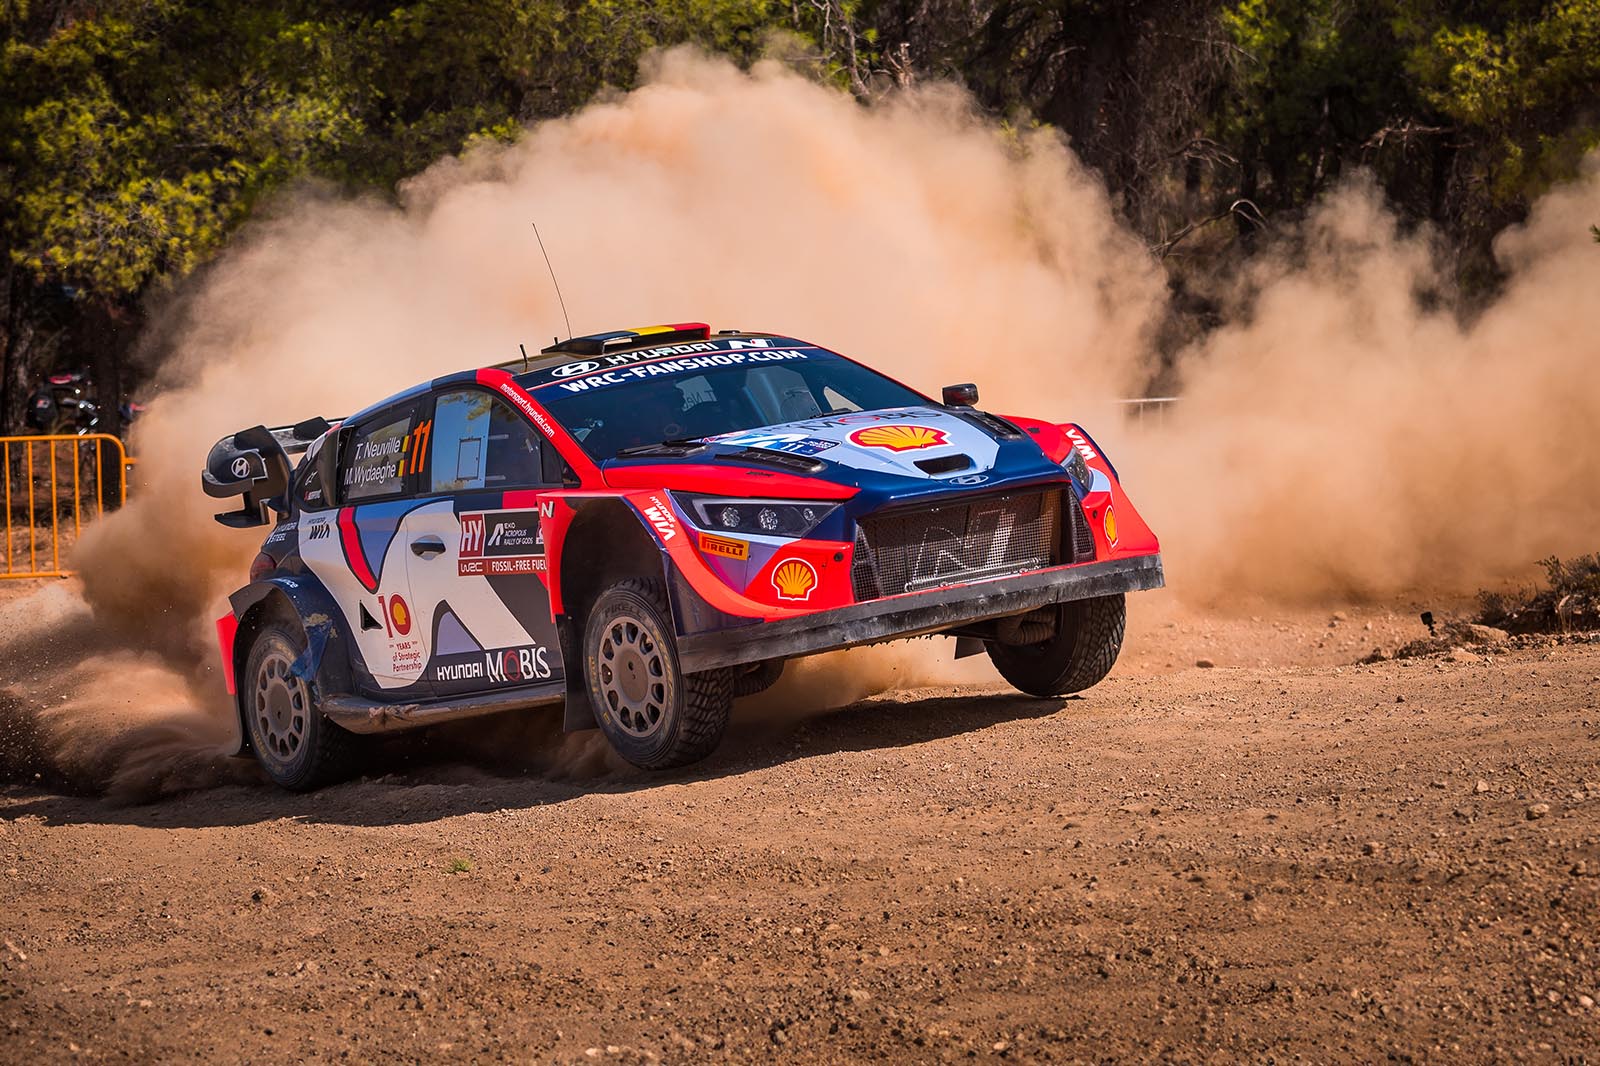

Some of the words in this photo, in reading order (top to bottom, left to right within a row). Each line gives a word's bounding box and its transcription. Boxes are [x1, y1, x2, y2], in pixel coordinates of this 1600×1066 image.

[604, 342, 719, 366] HYUNDAI
[559, 350, 808, 393] WRC-FANSHOP.COM
[500, 383, 556, 438] motorsport.hyundai.com
[355, 443, 364, 460] T.
[363, 437, 401, 459] Neuville
[410, 419, 432, 475] 11
[353, 462, 396, 487] Wydaeghe
[541, 501, 554, 518] N
[504, 522, 516, 530] EKO
[504, 529, 527, 537] ACROPOLIS
[643, 506, 676, 541] WIA
[460, 519, 482, 552] HY
[701, 535, 744, 556] PIRELLI
[460, 562, 483, 573] WRC
[491, 560, 531, 572] FOSSIL-FREE
[531, 559, 547, 571] FUEL
[392, 652, 398, 661] of
[398, 649, 421, 661] Strategic
[396, 641, 411, 650] YEARS
[392, 661, 422, 672] Partnership
[436, 661, 484, 681] HYUNDAI
[485, 646, 551, 682] MOBIS
